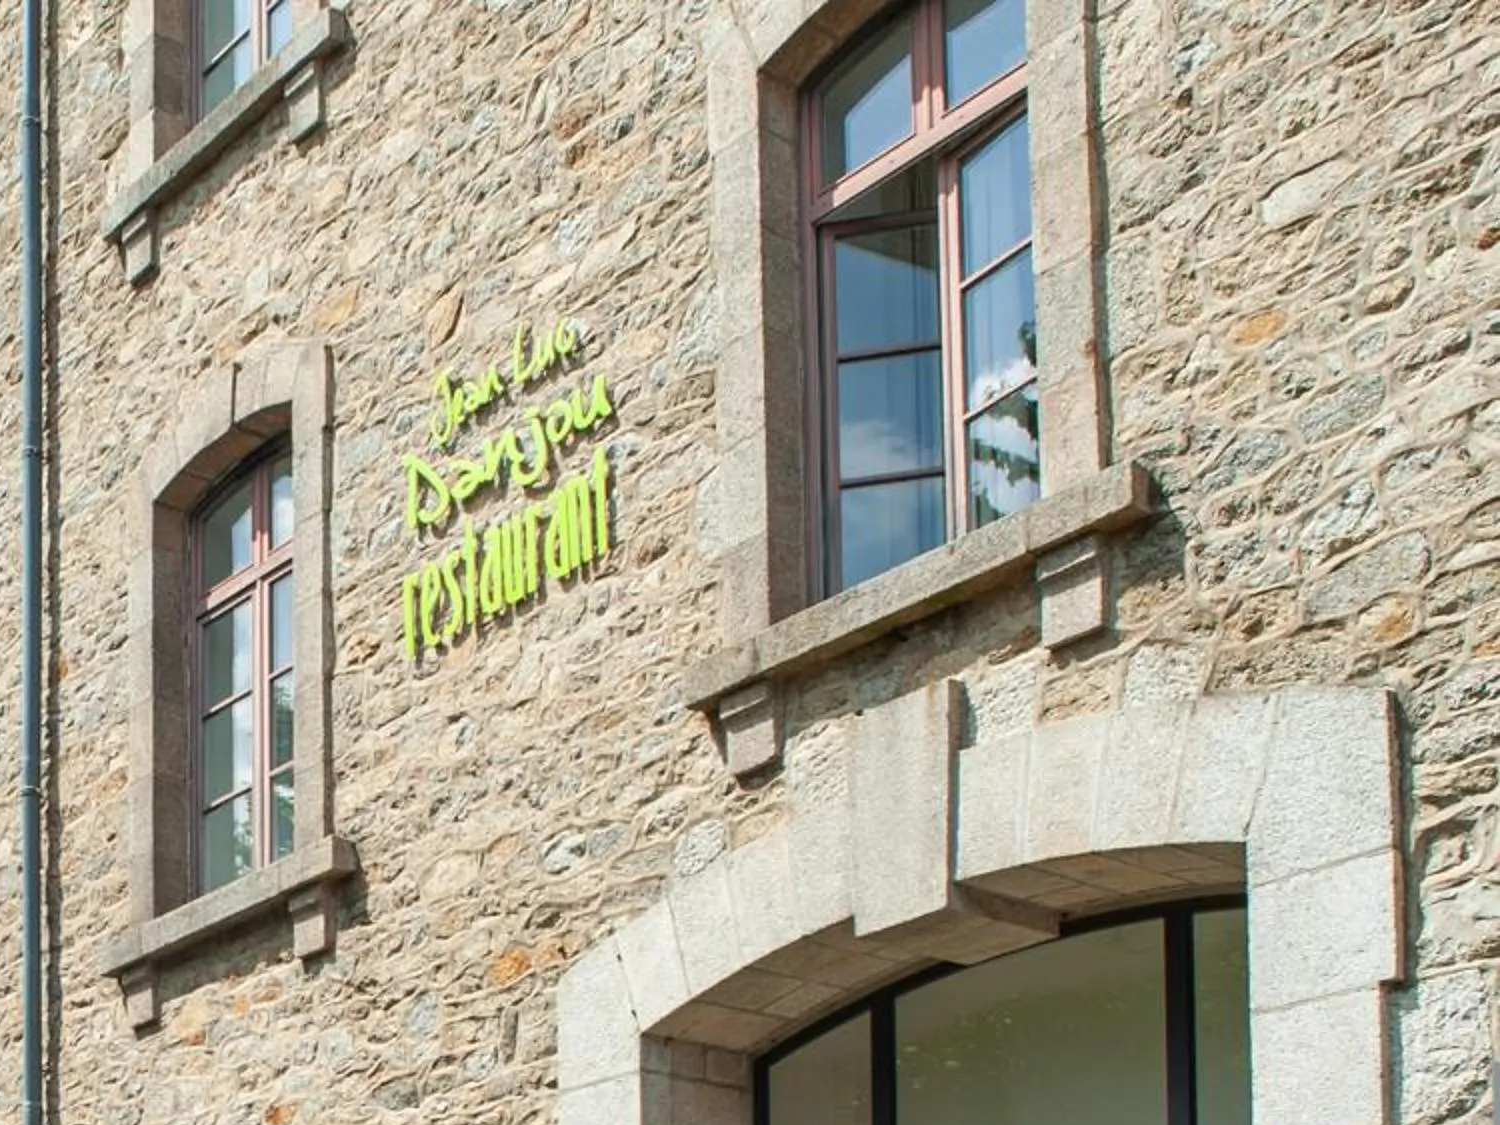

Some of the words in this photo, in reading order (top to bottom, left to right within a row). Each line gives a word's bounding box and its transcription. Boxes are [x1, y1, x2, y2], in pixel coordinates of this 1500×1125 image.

[402, 373, 614, 530] Danjou
[430, 367, 503, 446] Jean
[512, 317, 577, 385] Luc
[402, 445, 610, 659] restaurant
